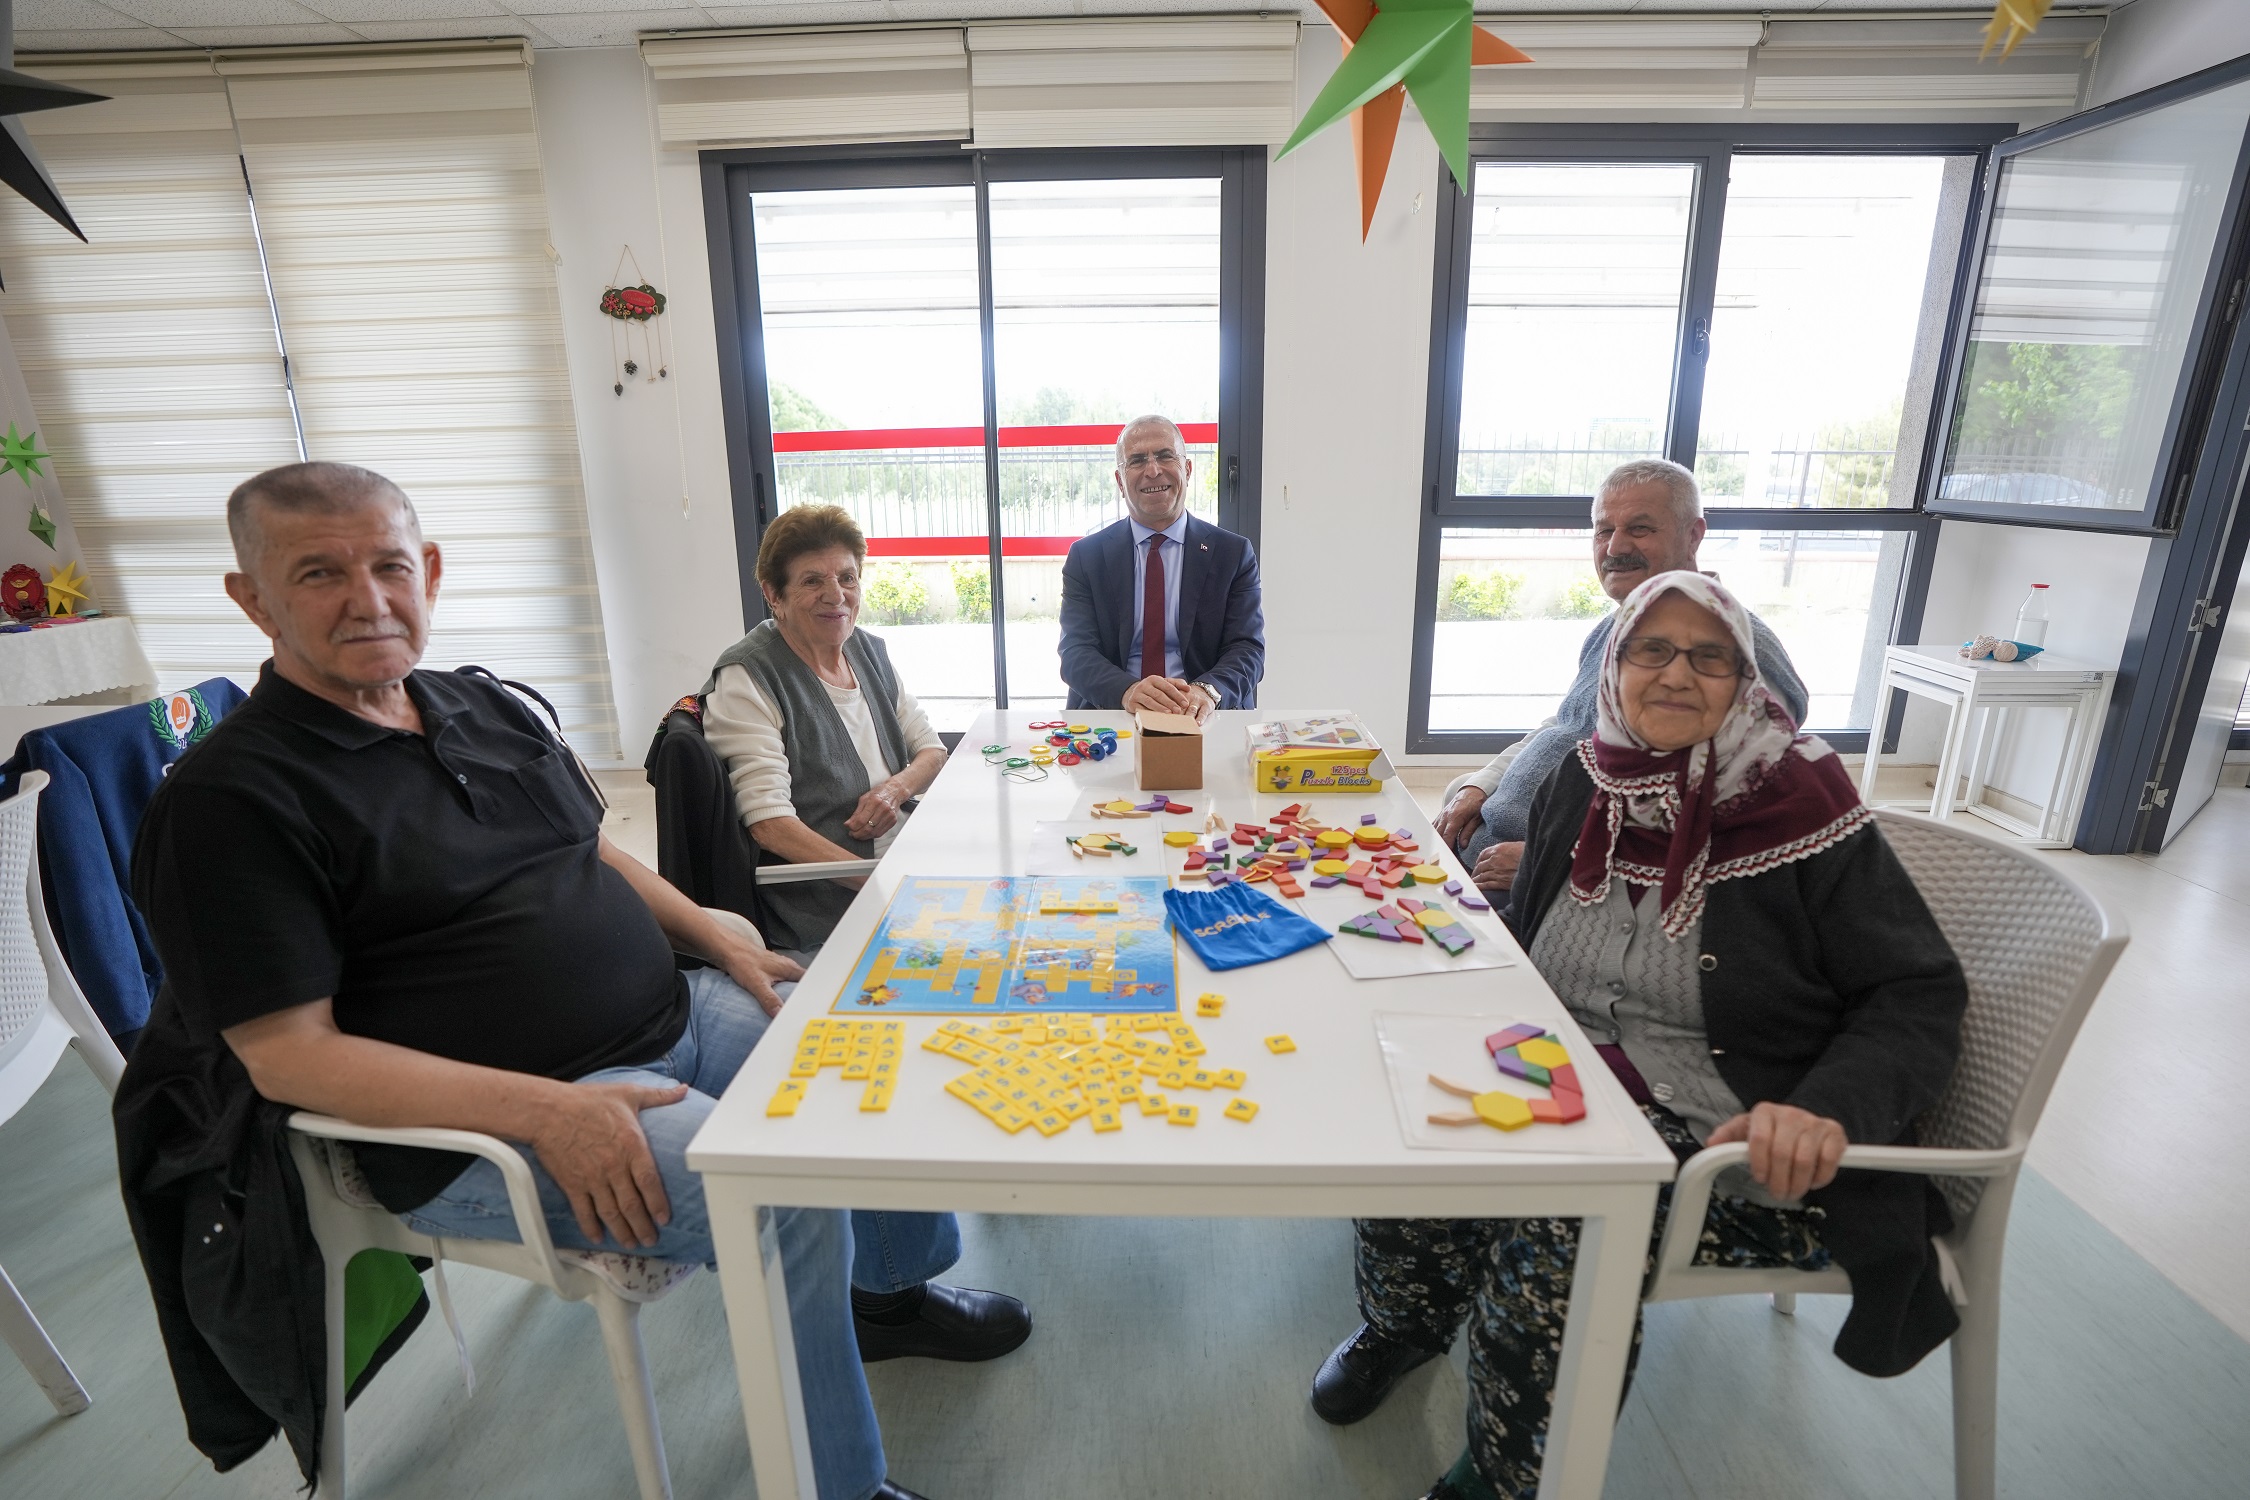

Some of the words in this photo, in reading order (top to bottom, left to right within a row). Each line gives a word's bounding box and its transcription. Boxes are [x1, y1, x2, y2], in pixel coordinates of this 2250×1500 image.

[1300, 769, 1334, 785] Puzzle
[1338, 776, 1371, 785] Blocks
[1331, 765, 1367, 777] 125pcs
[1193, 910, 1271, 937] SCRALE
